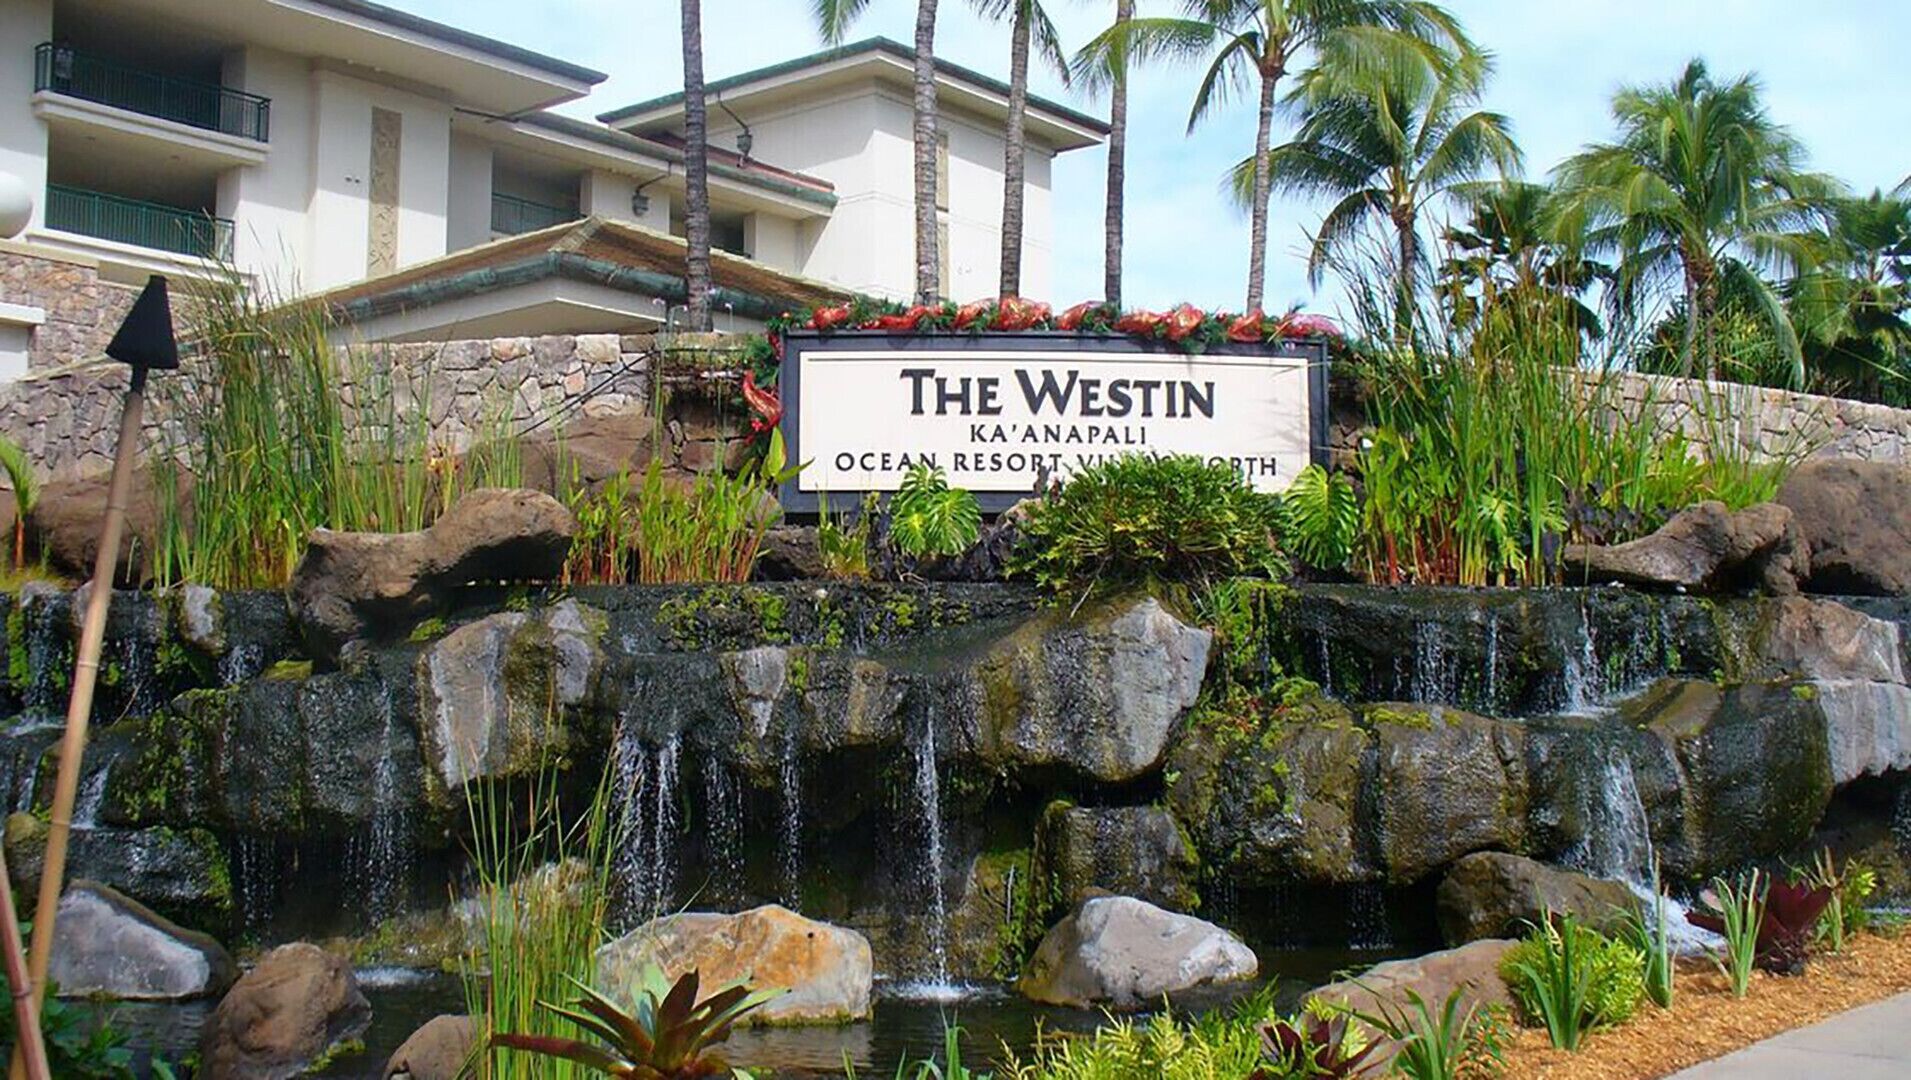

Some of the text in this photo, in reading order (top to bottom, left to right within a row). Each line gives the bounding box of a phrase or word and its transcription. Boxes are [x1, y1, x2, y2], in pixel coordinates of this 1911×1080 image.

[900, 368, 1215, 418] THE WESTIN
[835, 452, 936, 472] OCEAN
[953, 453, 1063, 472] RESORT
[1195, 456, 1276, 476] ORTH
